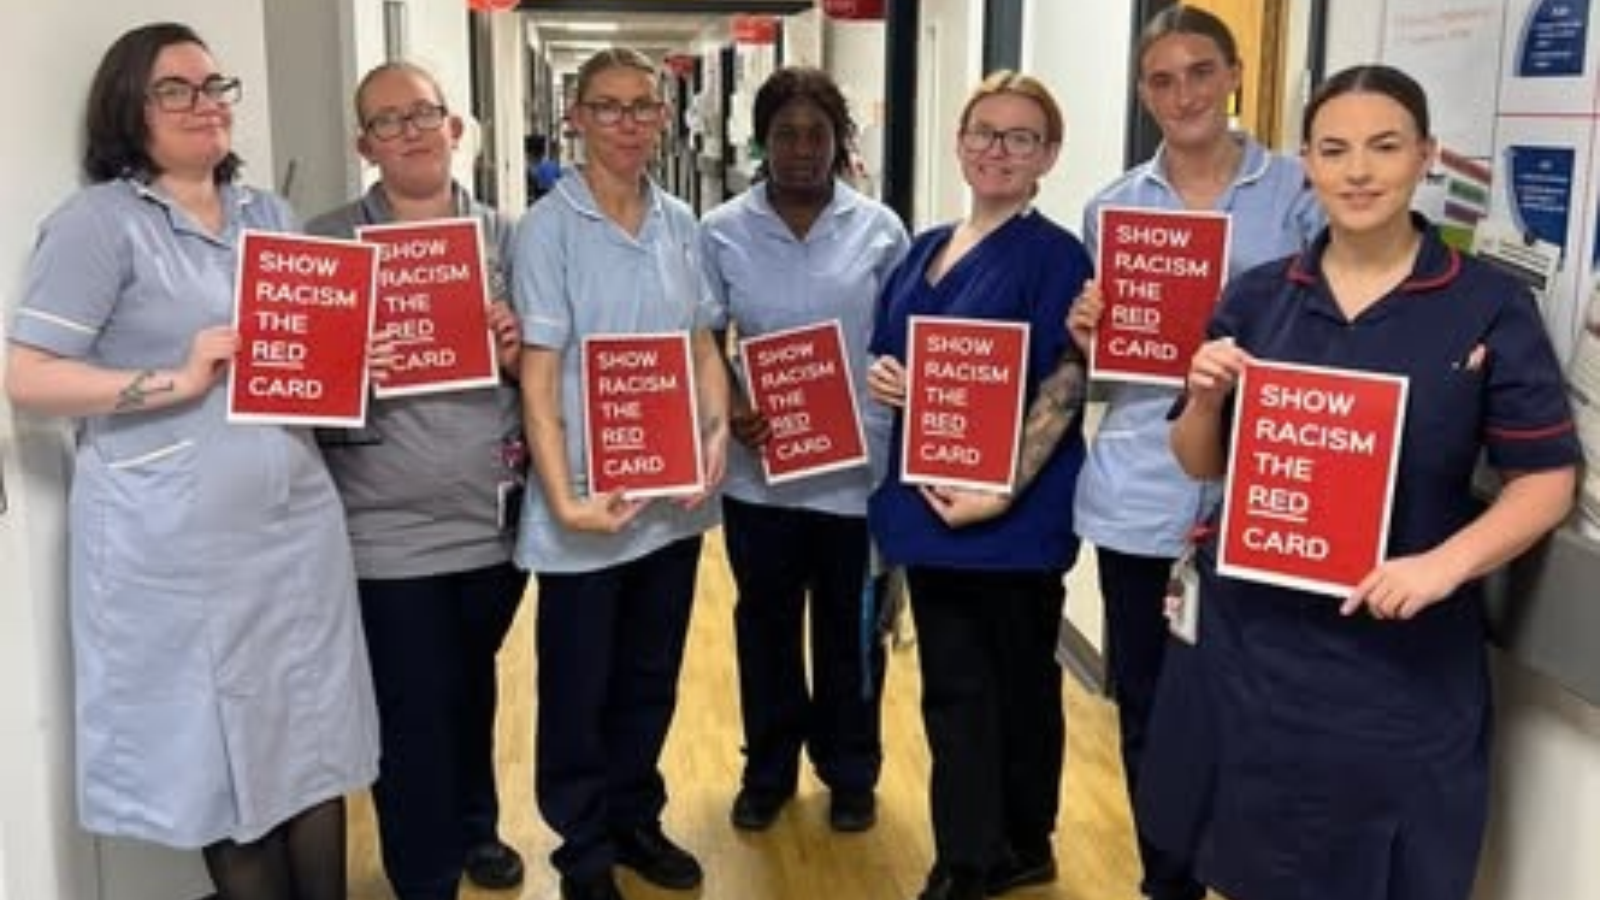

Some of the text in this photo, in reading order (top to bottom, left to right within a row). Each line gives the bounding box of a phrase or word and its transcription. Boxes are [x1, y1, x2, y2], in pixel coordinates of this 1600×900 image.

[1116, 225, 1192, 248] SHOW
[379, 239, 447, 261] SHOW
[259, 252, 339, 277] SHOW
[379, 264, 470, 287] RACISM
[1115, 252, 1209, 278] RACISM
[256, 281, 357, 308] RACISM
[1114, 278, 1162, 301] THE
[384, 293, 431, 313] THE
[257, 311, 308, 334] THE
[385, 318, 434, 338] RED
[1111, 305, 1161, 328] RED
[252, 340, 307, 363] RED
[757, 342, 814, 366] SHOW
[926, 335, 995, 356] SHOW
[1108, 337, 1179, 361] CARD
[391, 348, 456, 371] CARD
[597, 351, 658, 370] SHOW
[761, 361, 835, 388] RACISM
[924, 360, 1009, 385] RACISM
[249, 376, 322, 399] CARD
[599, 376, 677, 395] RACISM
[925, 387, 968, 407] THE
[601, 402, 641, 420] THE
[768, 389, 805, 411] THE
[1260, 383, 1356, 417] SHOW
[771, 412, 810, 434] RED
[922, 412, 967, 433] RED
[602, 427, 644, 445] RED
[776, 435, 831, 460] CARD
[1255, 418, 1376, 456] RACISM
[919, 442, 980, 466] CARD
[603, 455, 664, 477] CARD
[1253, 452, 1315, 482] THE
[1248, 484, 1310, 515] RED
[1242, 526, 1329, 561] CARD
